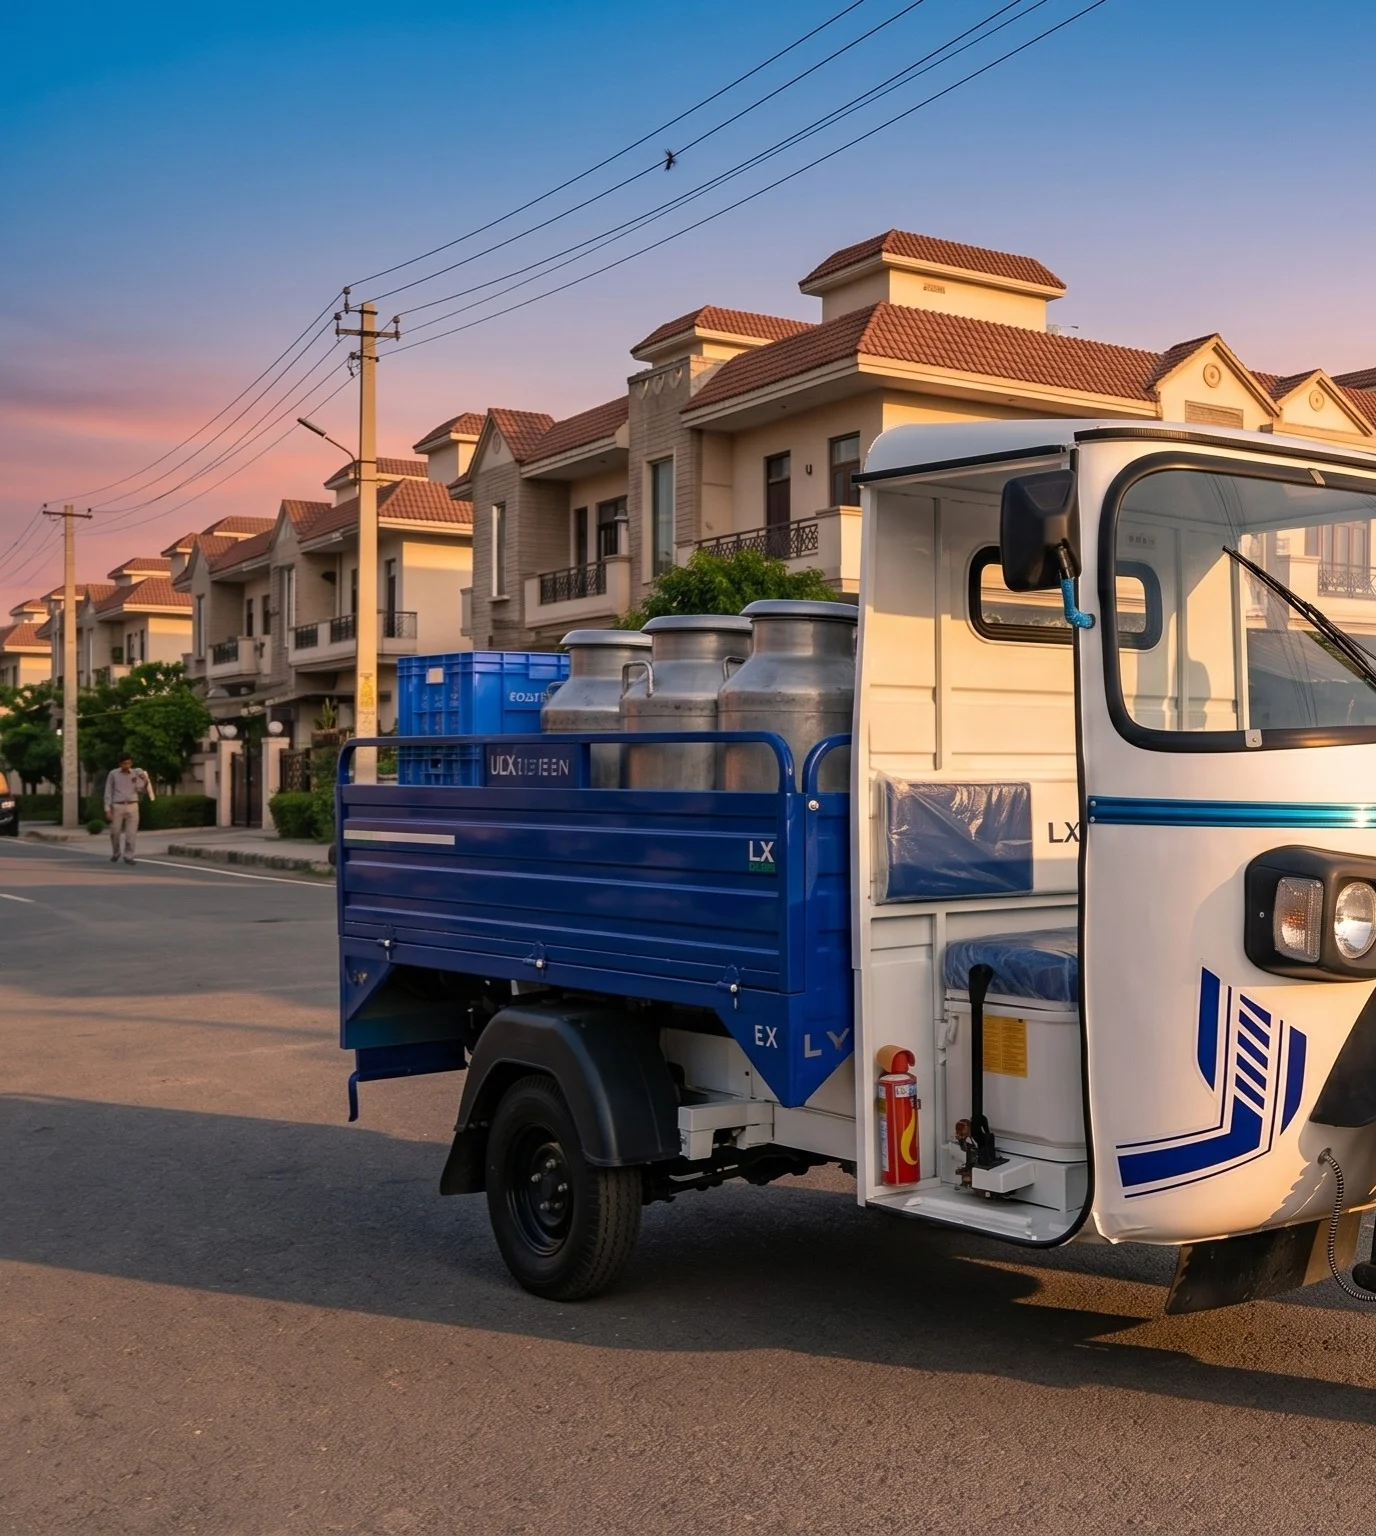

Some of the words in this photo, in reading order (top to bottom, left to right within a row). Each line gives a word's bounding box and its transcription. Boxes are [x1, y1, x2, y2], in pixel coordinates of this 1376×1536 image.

[1048, 821, 1080, 843] LX
[749, 840, 775, 863] LX
[754, 1024, 778, 1049] EX
